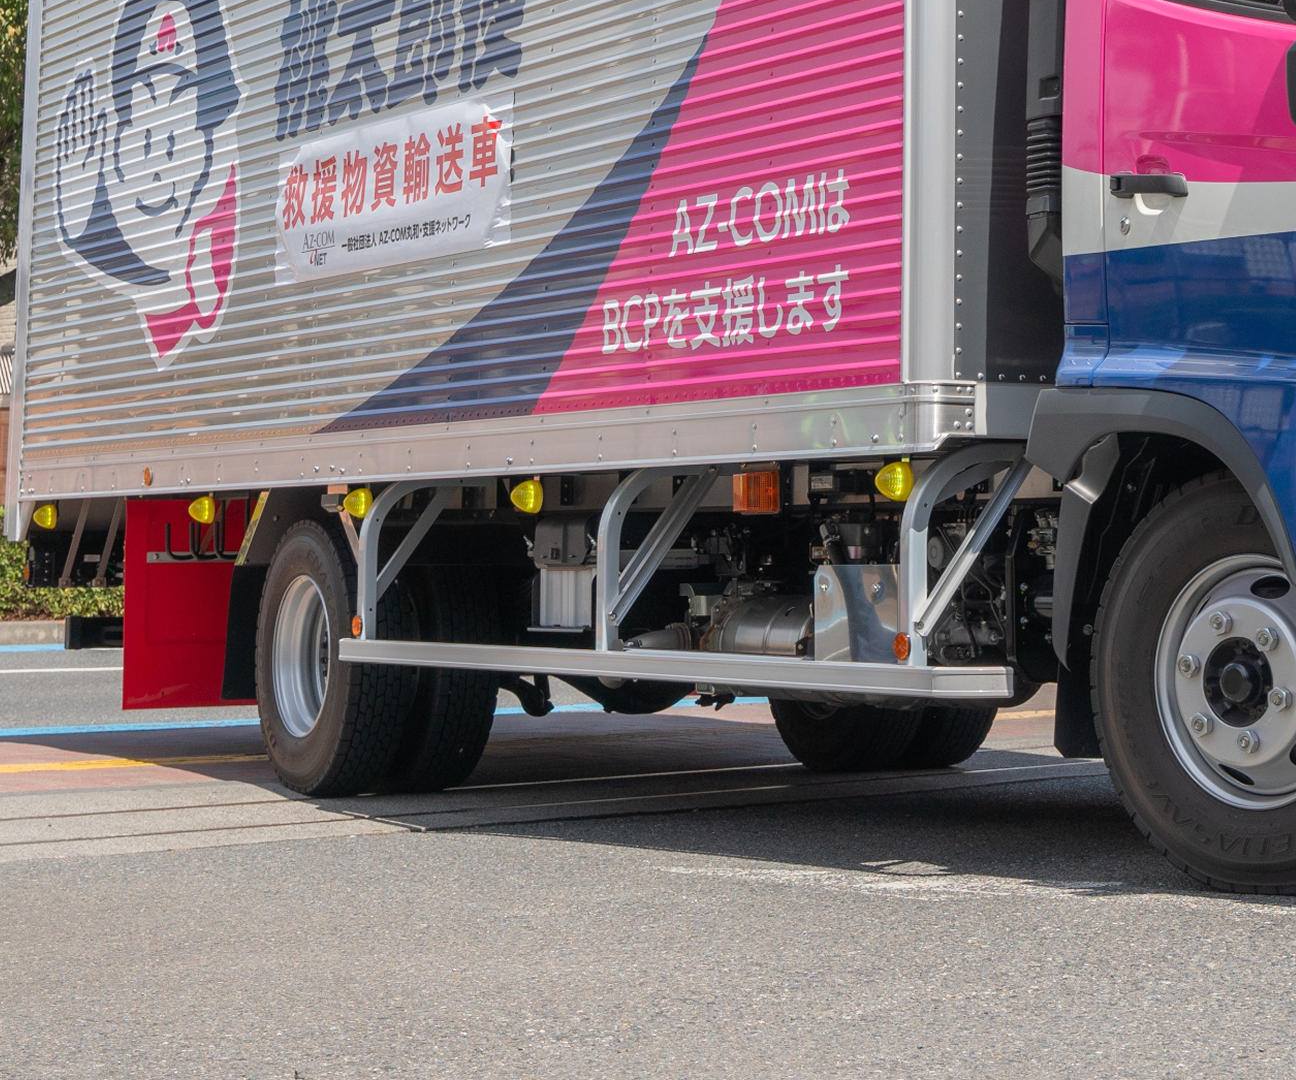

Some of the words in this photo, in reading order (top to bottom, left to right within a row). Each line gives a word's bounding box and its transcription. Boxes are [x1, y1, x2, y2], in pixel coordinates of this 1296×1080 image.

[282, 116, 503, 231] 救援物資輸送車
[669, 169, 850, 258] AZ-COMは
[303, 230, 335, 251] AZ-COM
[341, 234, 377, 253] 一般社団法人
[601, 264, 850, 354] BCPを支援します
